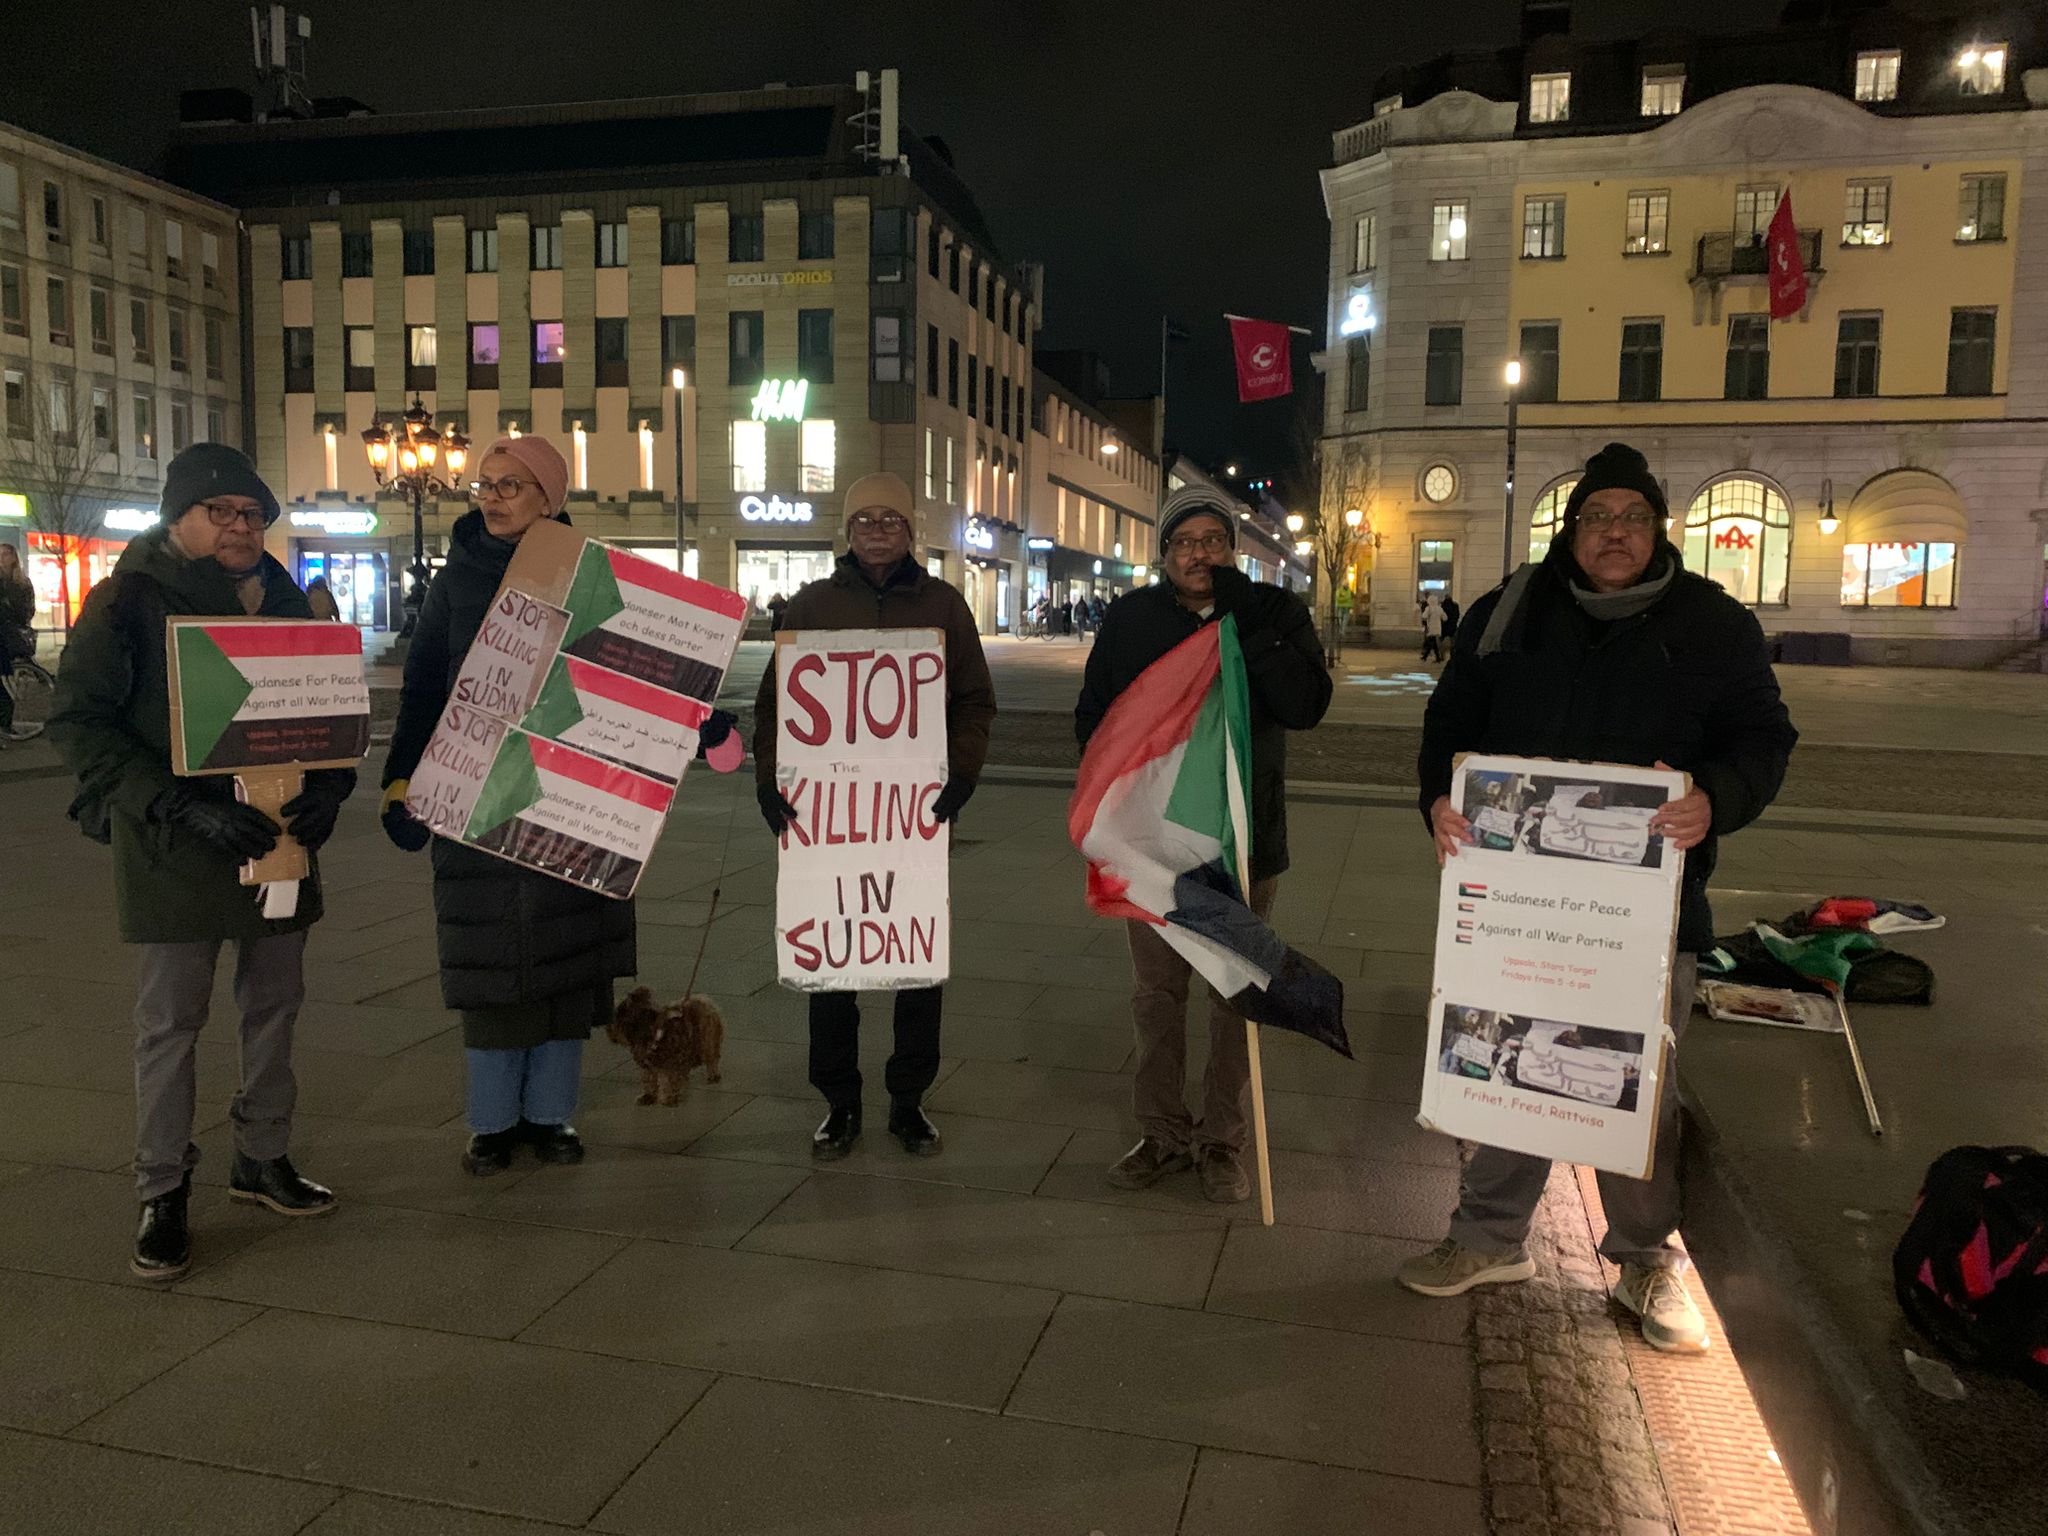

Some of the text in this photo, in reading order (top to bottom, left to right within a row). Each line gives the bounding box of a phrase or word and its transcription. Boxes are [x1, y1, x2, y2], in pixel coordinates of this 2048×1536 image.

[740, 494, 813, 522] Cubus
[1715, 525, 1754, 549] MAX
[500, 589, 548, 631] STOP
[619, 619, 703, 652] och dess Parter
[667, 614, 690, 630] Mot
[693, 620, 725, 641] Kriget
[306, 674, 327, 686] For
[486, 664, 513, 687] IN
[243, 698, 286, 712] Against
[290, 696, 303, 707] all
[309, 696, 330, 706] War
[457, 677, 521, 714] SUDAN
[785, 649, 944, 746] STOP
[446, 704, 497, 746] STOP
[587, 728, 636, 749] في السودان
[829, 761, 861, 774] The
[434, 781, 461, 804] IN
[528, 804, 565, 823] Against
[567, 818, 581, 828] all
[582, 821, 603, 836] War
[605, 831, 640, 851] Parties
[588, 804, 609, 820] For
[611, 812, 641, 833] Peace
[836, 870, 895, 915] IN
[1491, 889, 1632, 918] Sudanese For Peace
[785, 915, 936, 972] SUDAN
[1476, 921, 1624, 950] Against all War Parties
[1511, 1098, 1546, 1118] Fred,
